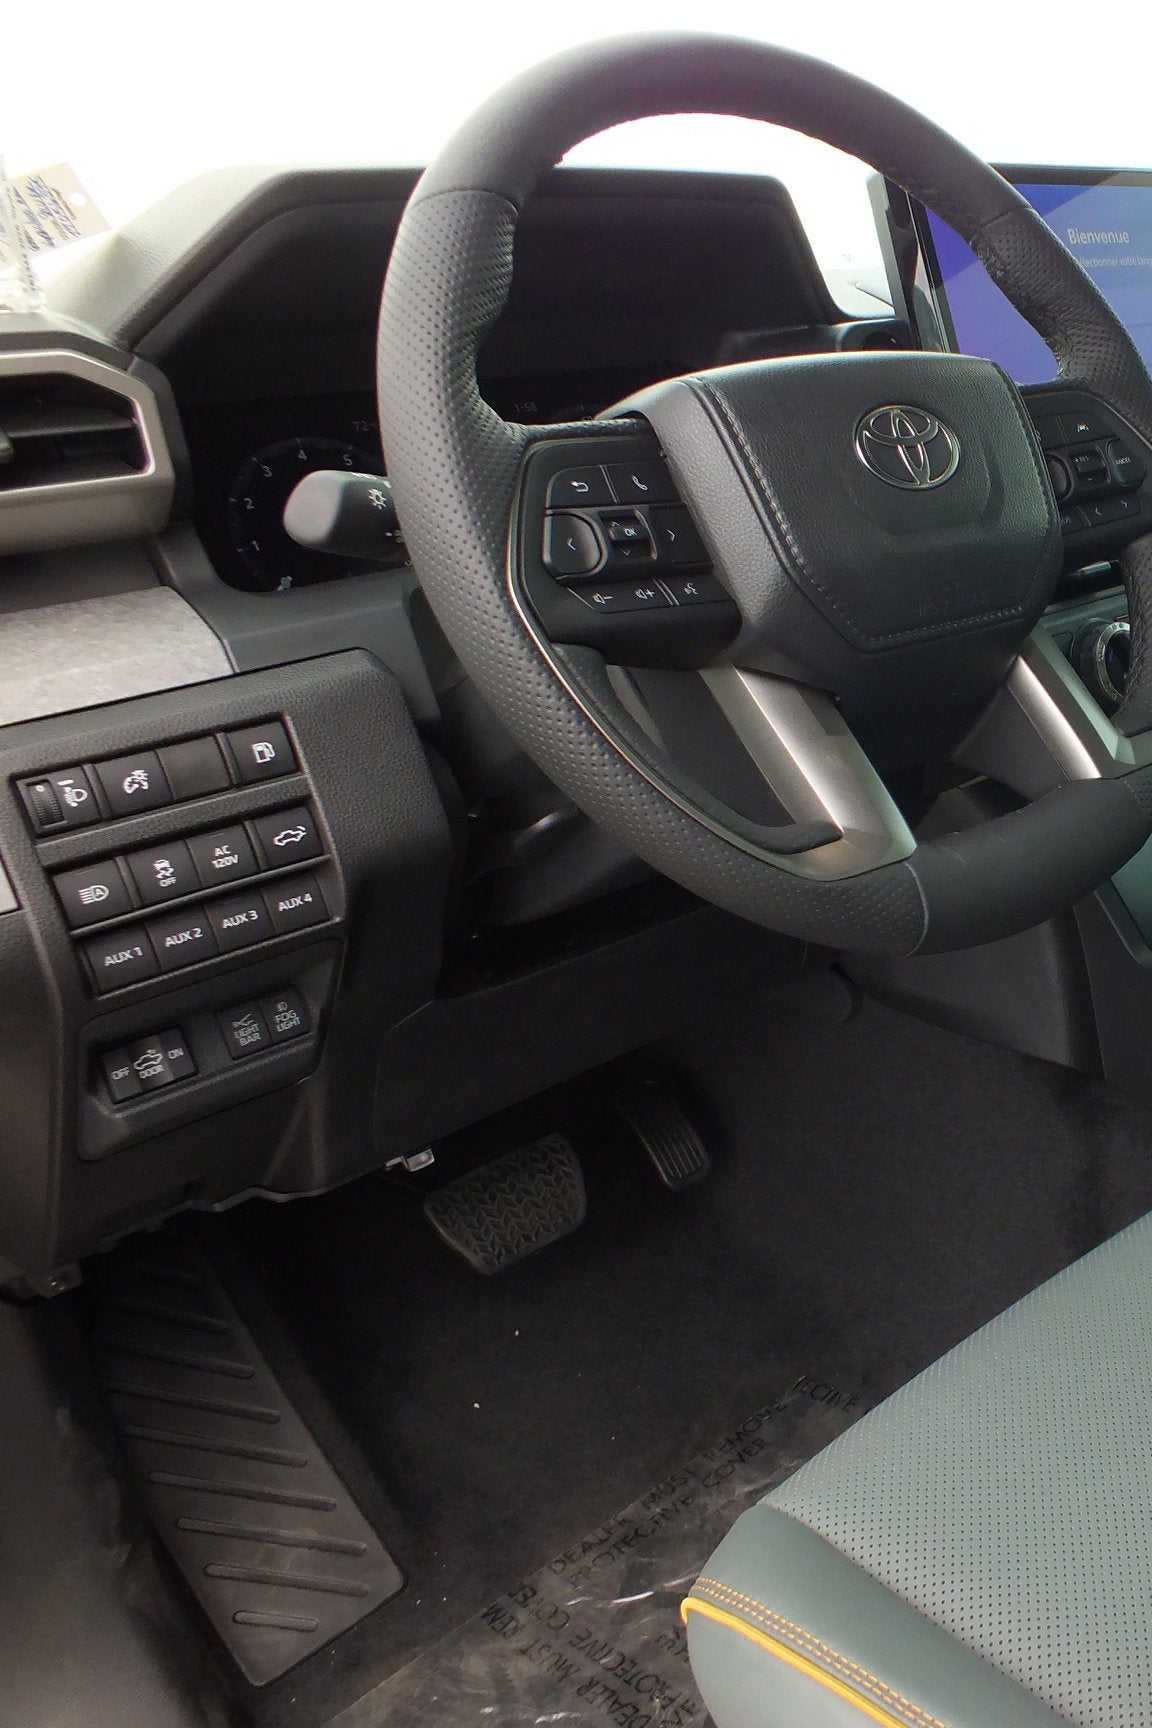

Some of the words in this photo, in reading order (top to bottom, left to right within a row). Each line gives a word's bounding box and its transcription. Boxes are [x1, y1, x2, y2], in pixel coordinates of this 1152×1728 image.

[1067, 228, 1130, 245] Bienvenue
[213, 844, 233, 857] AC
[212, 854, 239, 869] 120V
[159, 876, 177, 888] OFF
[277, 896, 304, 912] AUX
[303, 893, 314, 903] 4
[221, 913, 249, 929] AUX
[247, 910, 259, 921] 3
[164, 930, 194, 947] AUX
[193, 928, 204, 939] 2
[104, 949, 134, 967] AUX
[133, 946, 144, 958] 1
[274, 1009, 298, 1024] FOG
[234, 1023, 260, 1040] LIGHT
[276, 1017, 302, 1033] LIGHT
[238, 1032, 263, 1047] BAR
[168, 1047, 185, 1060] ON
[110, 1067, 130, 1081] OFF
[139, 1064, 165, 1079] DOOR
[703, 1436, 771, 1488] COVER
